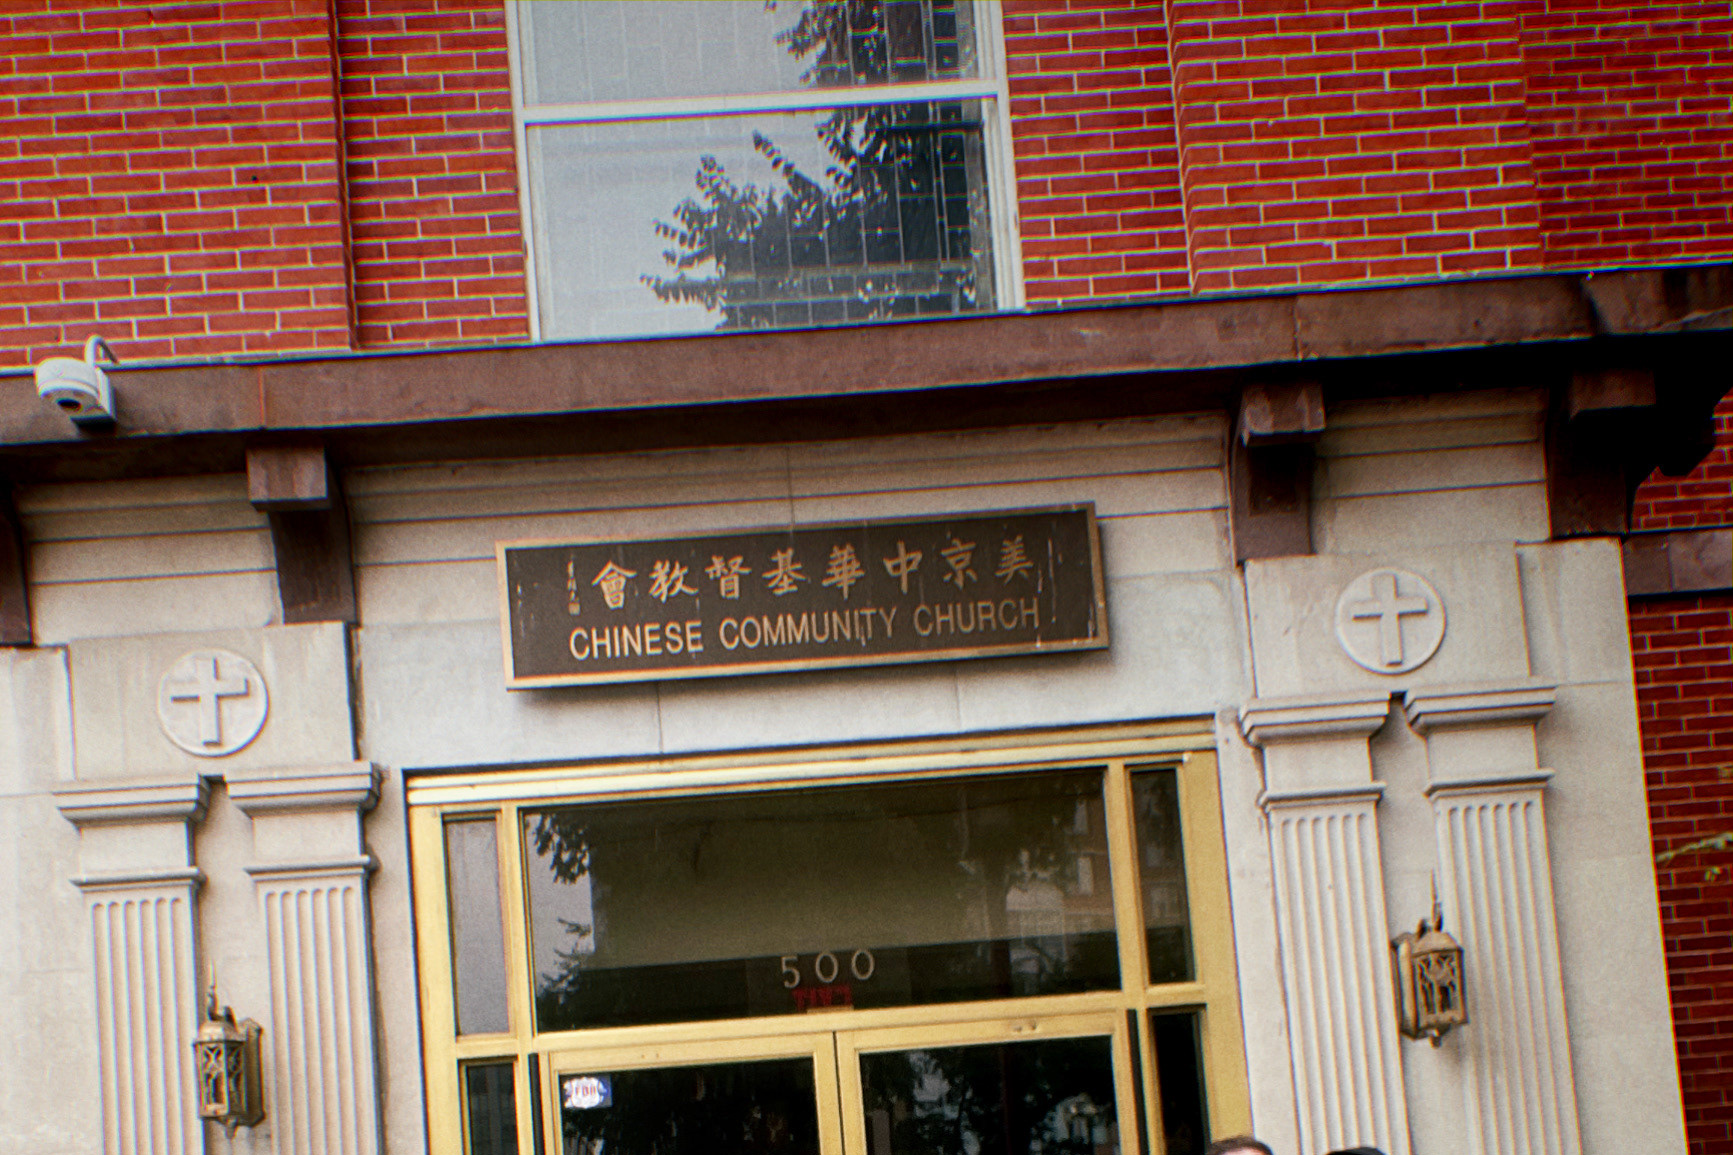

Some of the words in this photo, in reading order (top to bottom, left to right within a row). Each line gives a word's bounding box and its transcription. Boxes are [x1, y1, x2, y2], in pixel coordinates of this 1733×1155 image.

[569, 620, 704, 660] CHINESE
[719, 606, 898, 650] COMMUNITY
[914, 598, 1041, 637] CHURCH
[781, 950, 875, 989] 500
